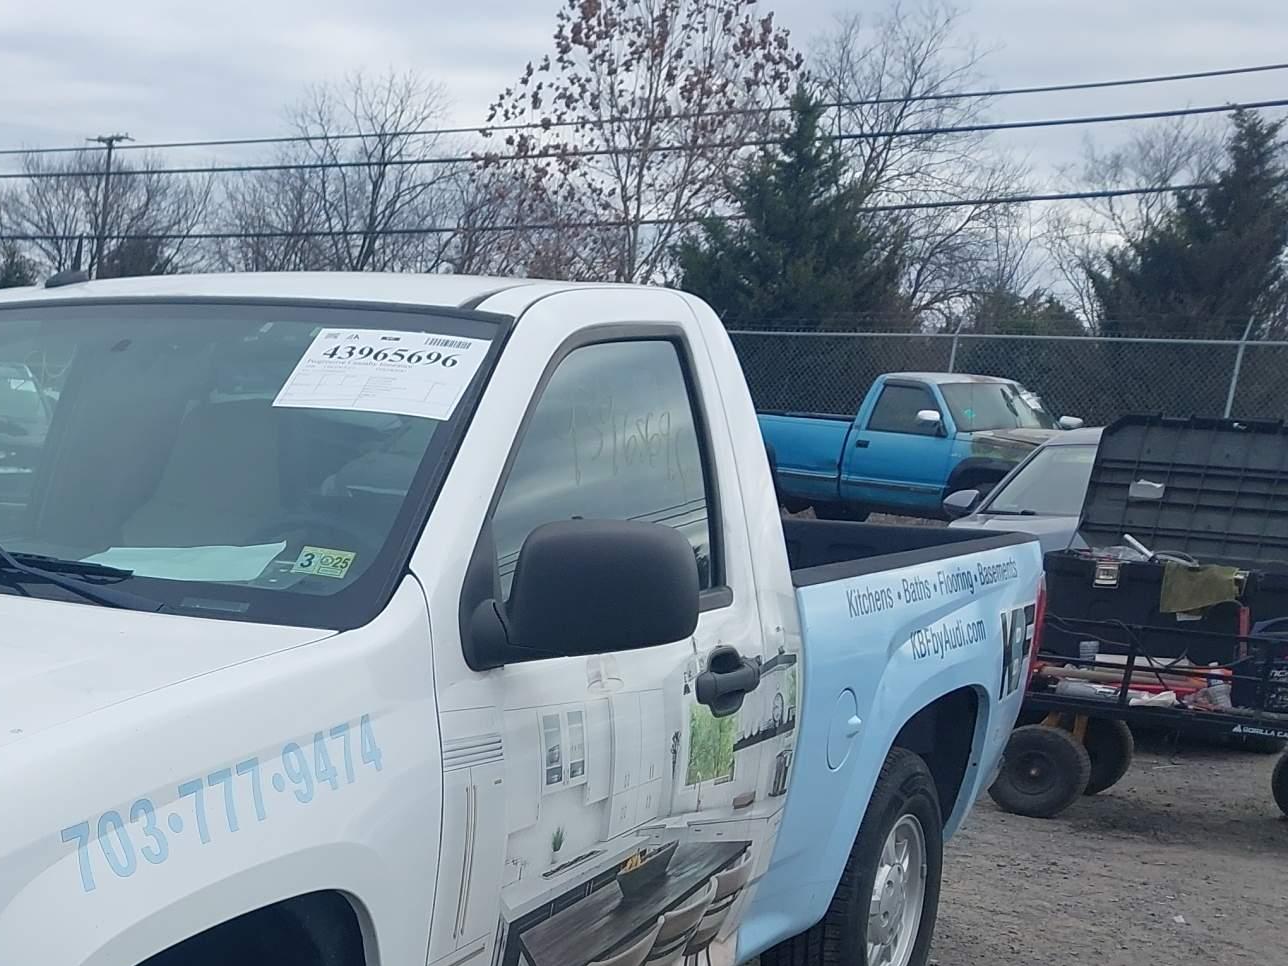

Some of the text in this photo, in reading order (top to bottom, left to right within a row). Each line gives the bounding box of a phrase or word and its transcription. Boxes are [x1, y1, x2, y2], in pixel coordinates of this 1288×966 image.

[323, 345, 462, 368] 43965696
[300, 553, 351, 569] 3 25
[846, 558, 1018, 618] Kitchens Baths Flooring Basements
[911, 618, 987, 660] KBFbyAudi.com
